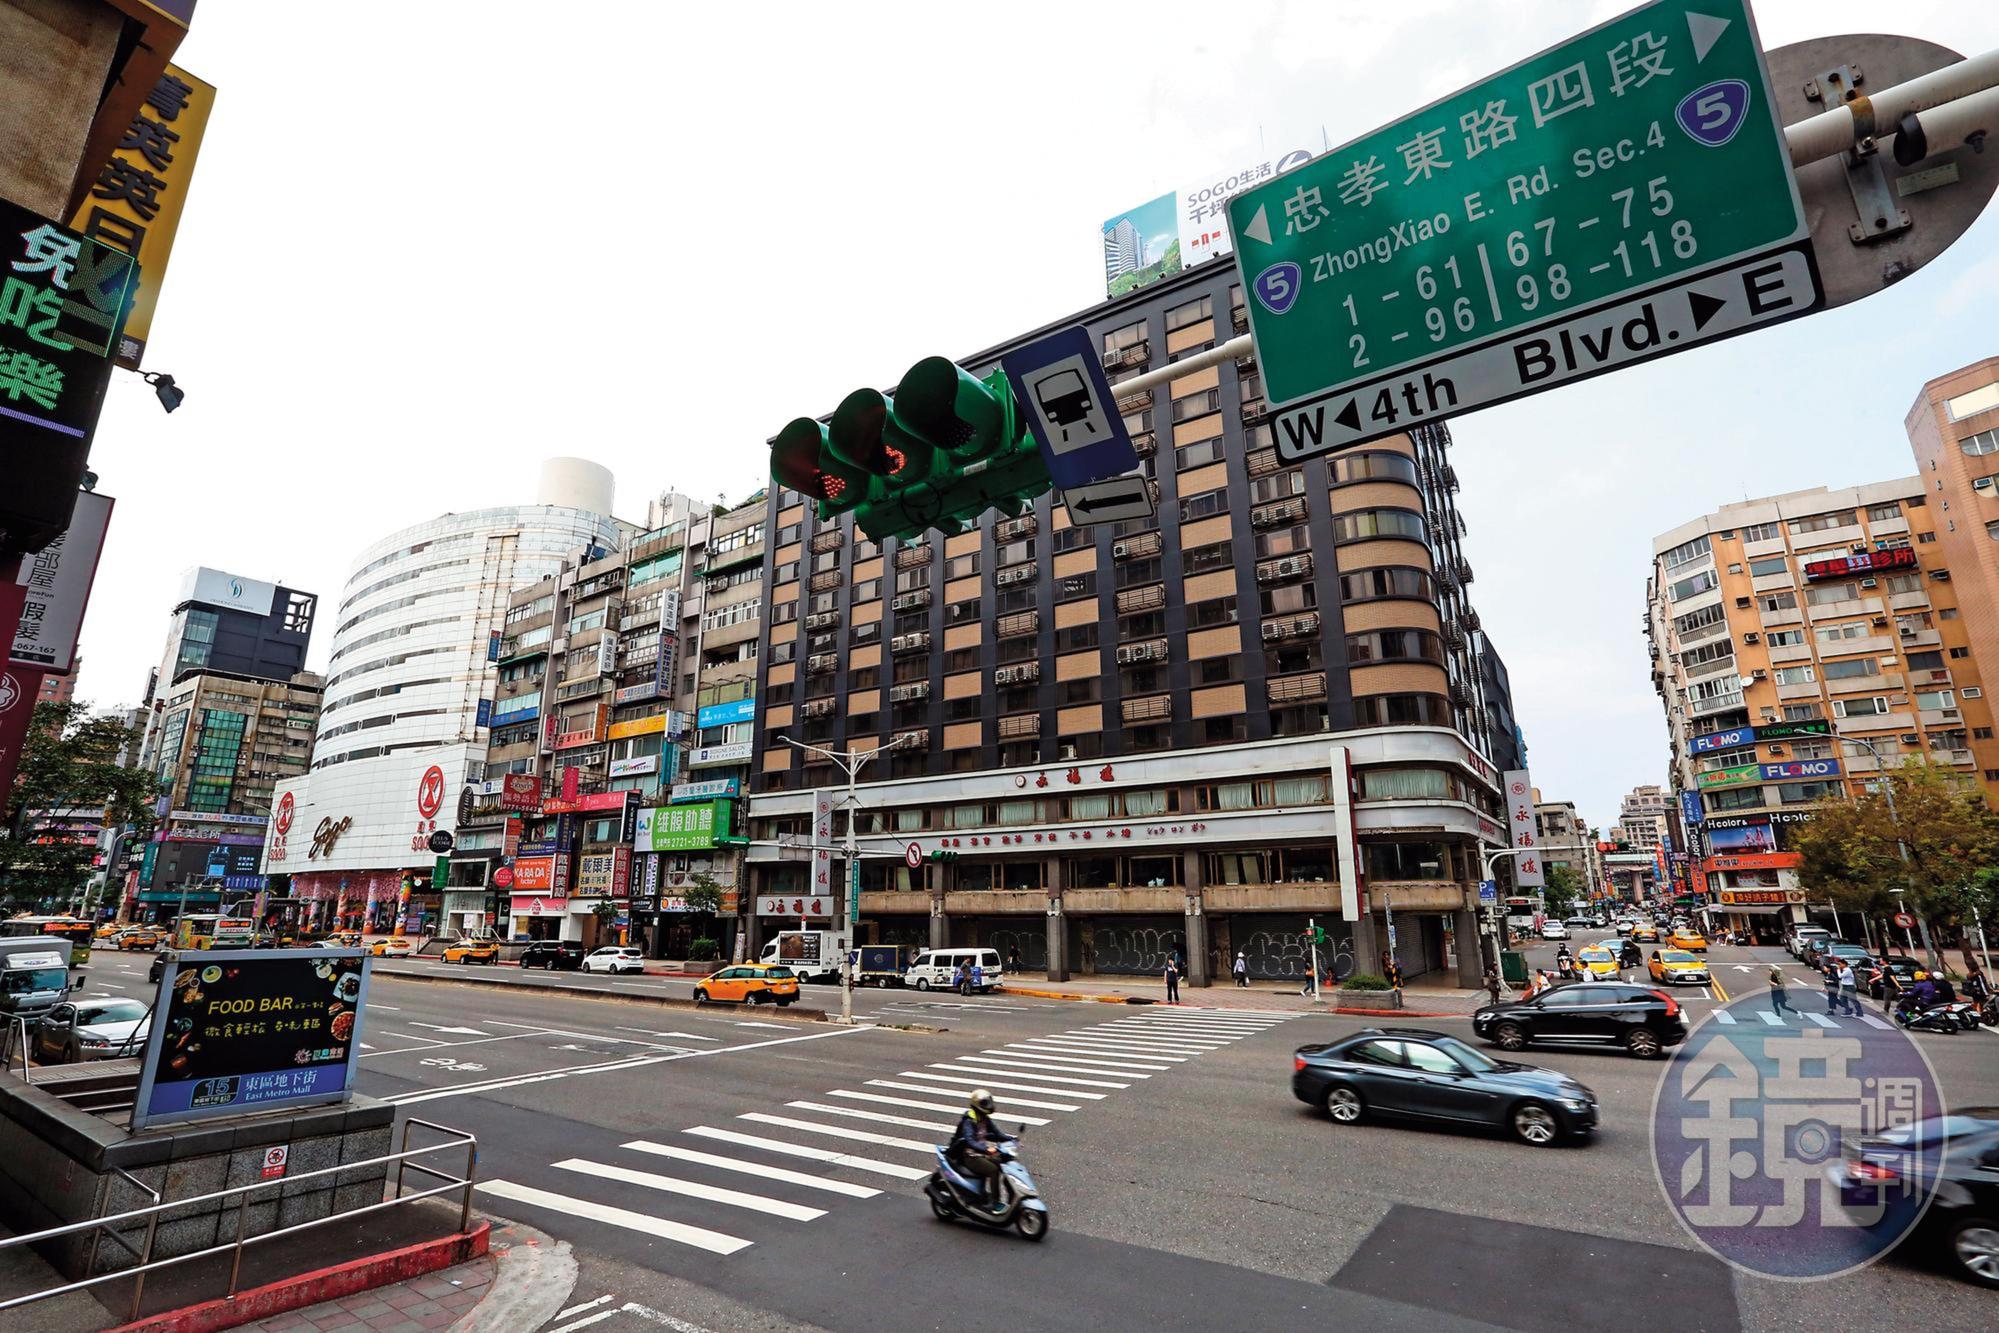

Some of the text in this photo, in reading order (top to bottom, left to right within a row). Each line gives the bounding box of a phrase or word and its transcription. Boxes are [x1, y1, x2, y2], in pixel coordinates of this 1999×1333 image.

[1697, 91, 1732, 130] 5
[1283, 31, 1675, 236] 忠孝東路四段
[1188, 161, 1271, 208] SOGO生活
[1310, 212, 1451, 283] ZhongXiao
[1463, 192, 1495, 223] E.
[1507, 166, 1559, 205] Rd.
[1265, 271, 1290, 301] 5
[1281, 261, 1794, 451] W 4th Blvd. E
[1697, 732, 1740, 750] FLOMO
[1766, 762, 1828, 777] FLOMO
[1515, 805, 1538, 874] 永福樓
[554, 854, 568, 898] 戴爾美語
[1479, 883, 1487, 892] P
[208, 999, 255, 1015] FOOD
[259, 997, 293, 1012] BAR
[205, 1078, 230, 1096] 15
[245, 1070, 318, 1091] 東區地下街
[245, 1085, 311, 1101] East Metro Mall
